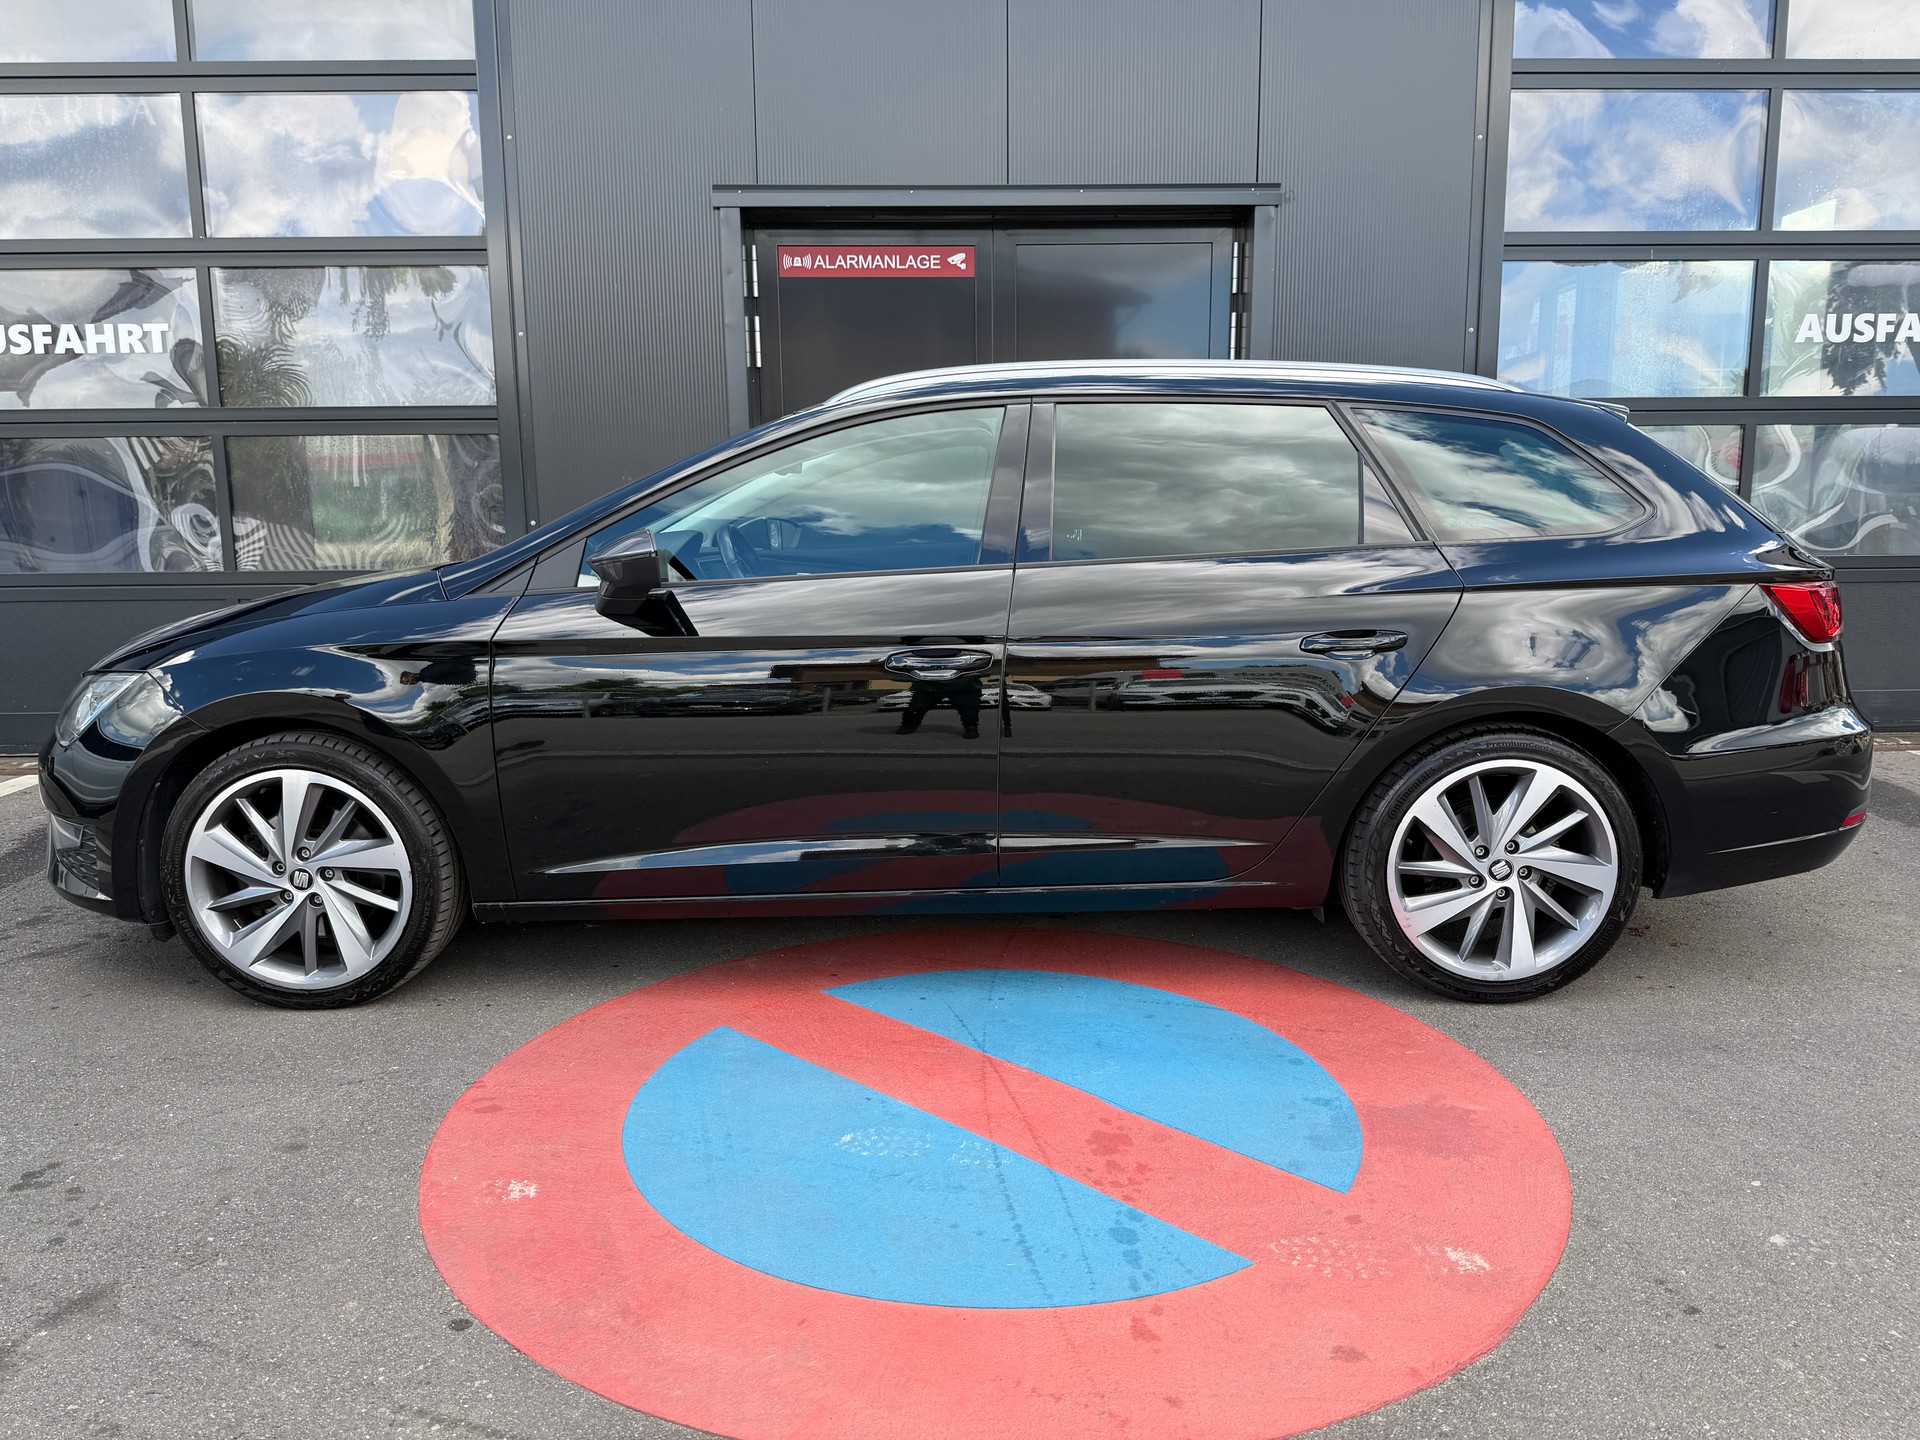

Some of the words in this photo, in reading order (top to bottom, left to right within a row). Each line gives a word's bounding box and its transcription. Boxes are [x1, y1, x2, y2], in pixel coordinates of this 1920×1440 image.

[814, 254, 941, 269] ALARMANLAGE
[0, 323, 169, 355] SFAHRT
[1794, 312, 1920, 343] AUSFA
